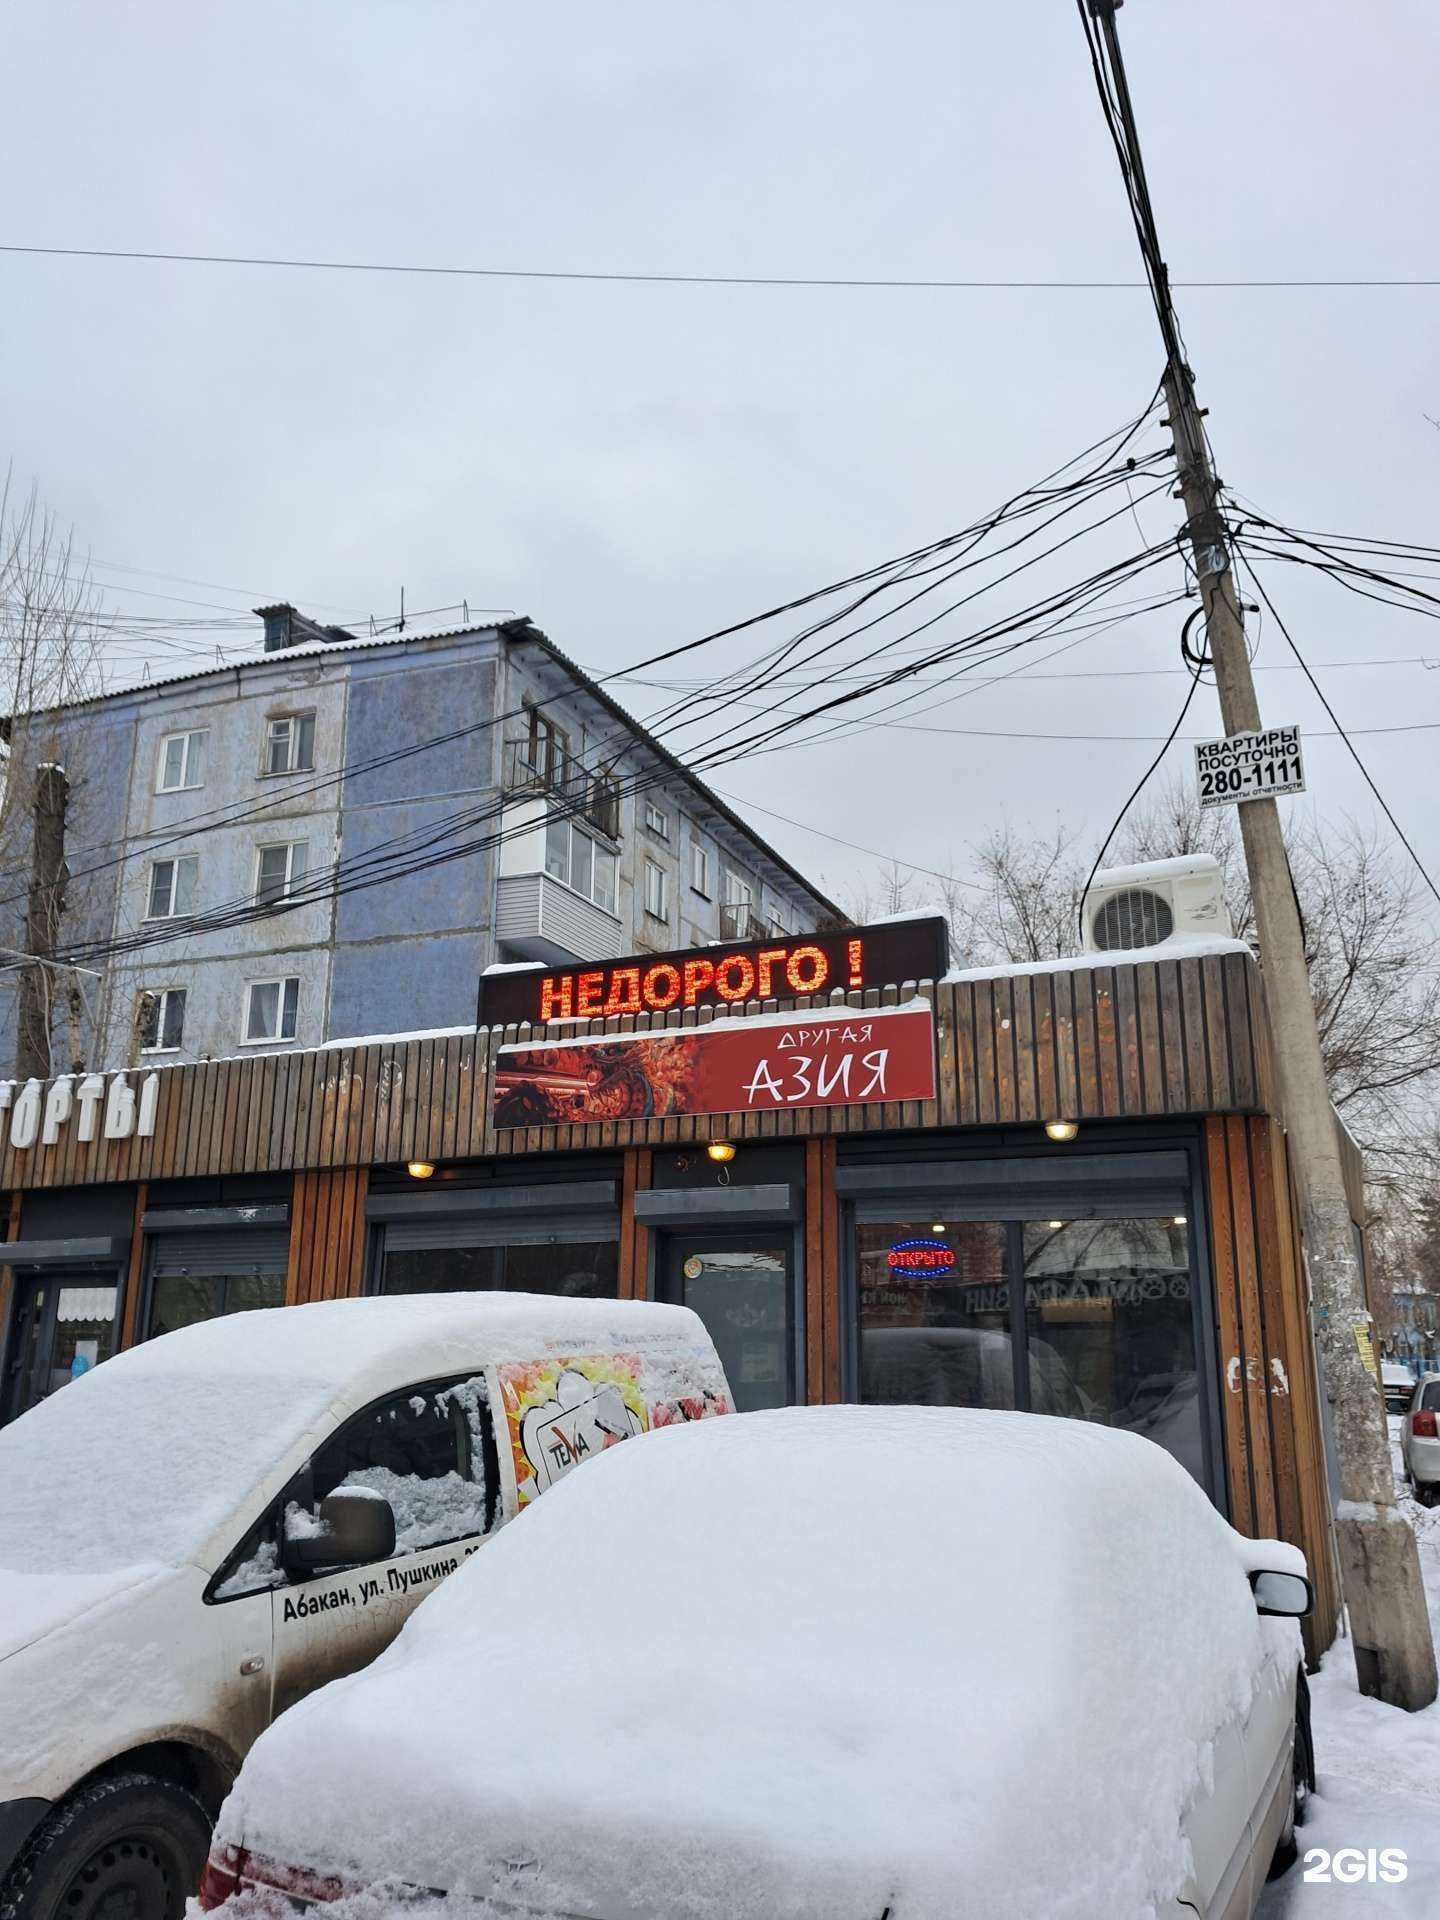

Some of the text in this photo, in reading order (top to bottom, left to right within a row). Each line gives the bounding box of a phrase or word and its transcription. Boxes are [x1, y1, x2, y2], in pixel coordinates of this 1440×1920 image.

[1197, 728, 1297, 758] КВАРТИРЫ
[1198, 743, 1298, 772] ПОСУТОЧНО
[1200, 756, 1301, 796] 280-1111
[541, 946, 829, 1020] НЕДОРОГО
[777, 1024, 873, 1050] ДРУГАЯ
[741, 1048, 890, 1104] АЗИЯ
[887, 1250, 955, 1267] ОТКРЫТО
[283, 1587, 356, 1622] Абакан,
[358, 1579, 384, 1605] ул.
